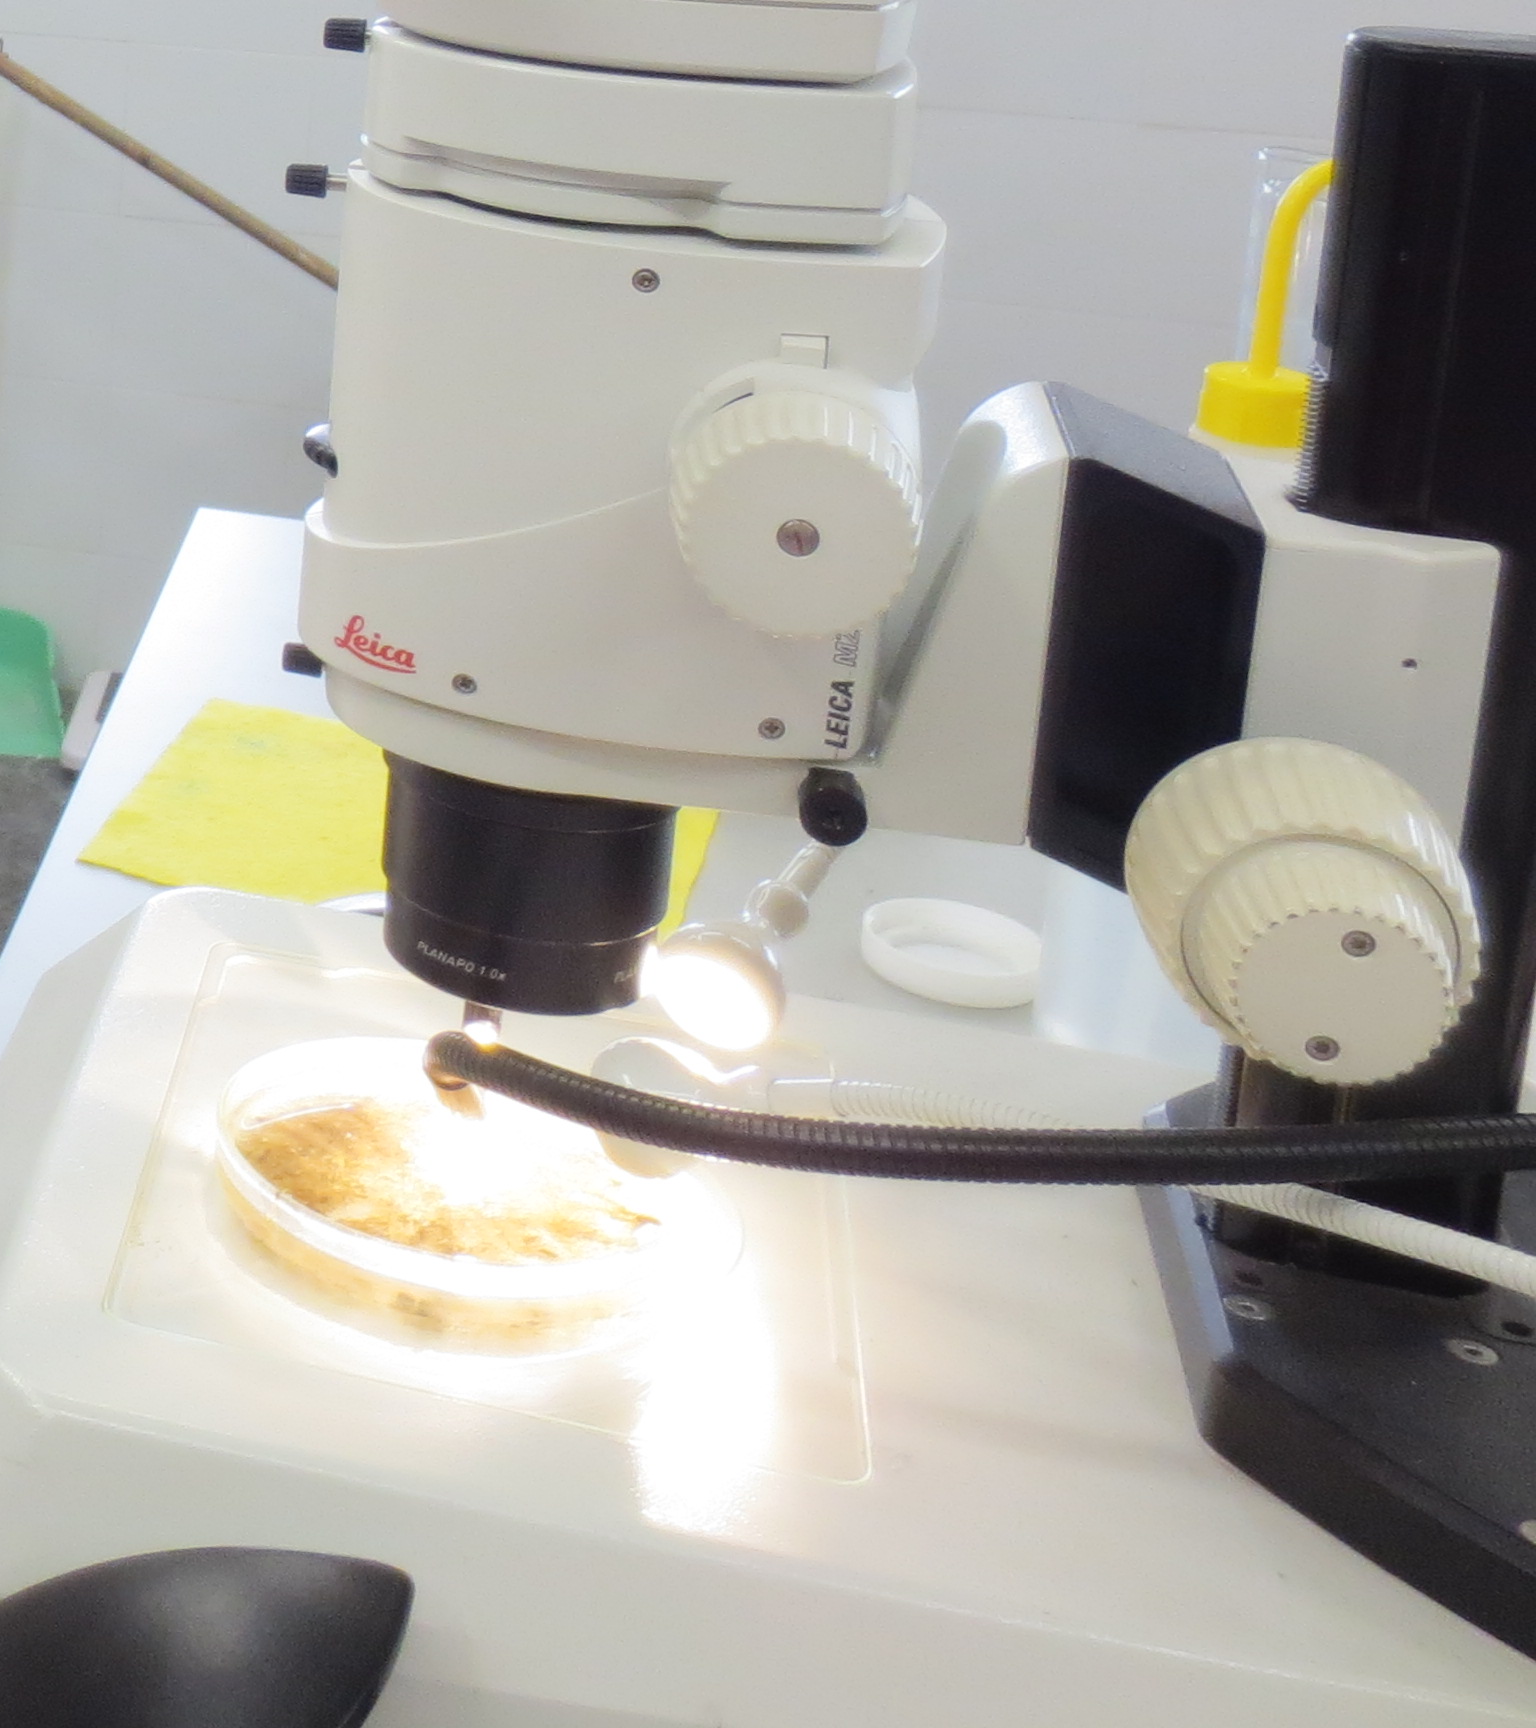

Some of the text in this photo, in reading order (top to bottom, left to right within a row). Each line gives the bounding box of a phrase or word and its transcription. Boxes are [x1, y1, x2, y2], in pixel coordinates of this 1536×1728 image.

[334, 615, 416, 674] Leica
[824, 680, 855, 749] LEICA
[417, 941, 475, 973] PLANAPO
